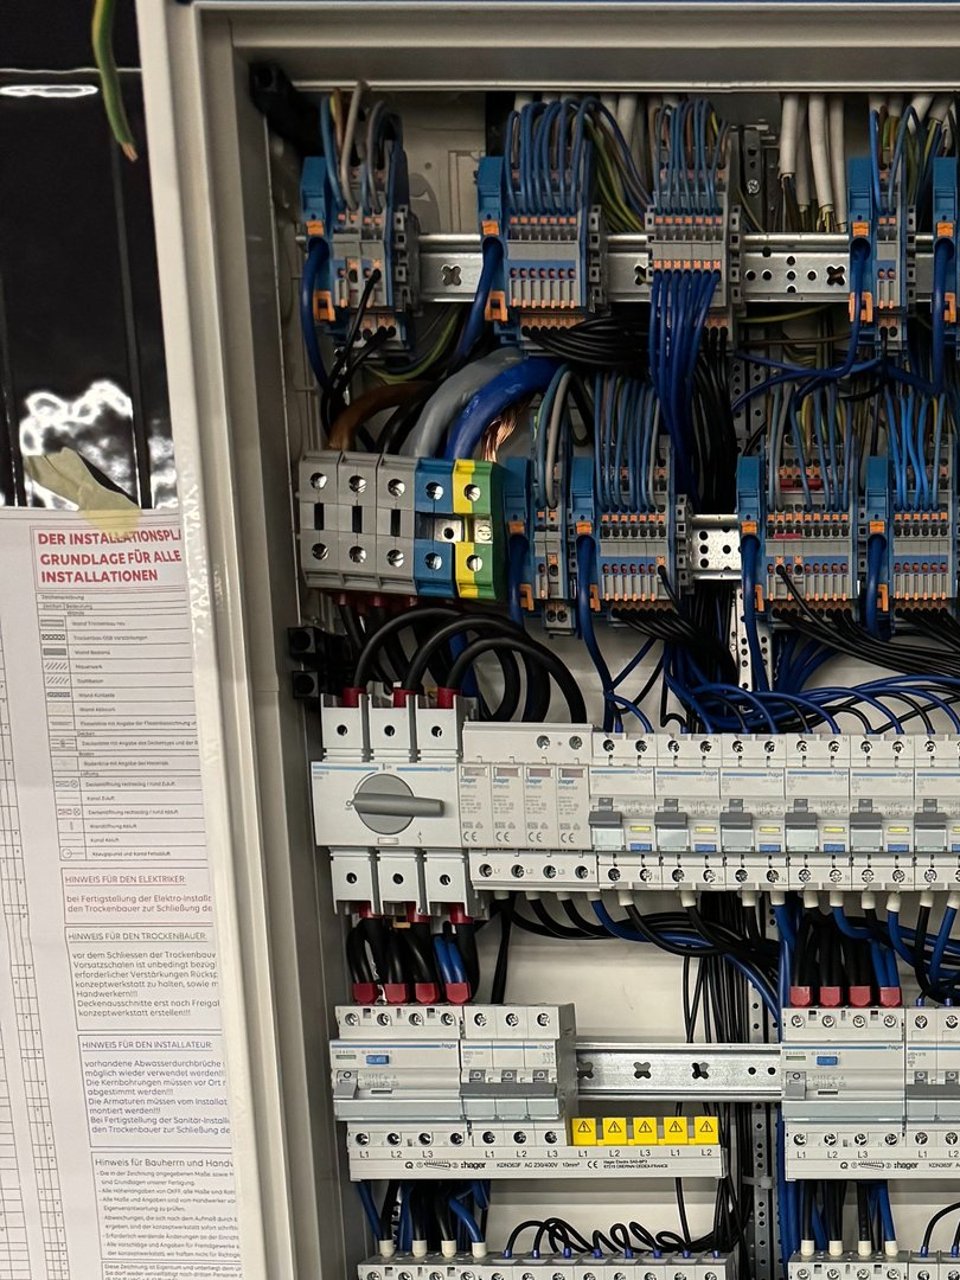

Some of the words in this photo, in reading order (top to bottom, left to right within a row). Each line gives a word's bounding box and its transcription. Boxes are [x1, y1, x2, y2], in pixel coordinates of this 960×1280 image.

[38, 533, 65, 545] DER
[40, 553, 125, 565] GRUNDLAGE
[128, 549, 150, 563] FÜR
[154, 550, 182, 562] ALLE
[42, 570, 158, 582] INSTALLATIONEN
[102, 875, 119, 883] FÜR
[81, 896, 136, 904] Fertigstellung
[157, 905, 200, 914] Schließung
[105, 932, 121, 940] FÜR
[148, 962, 188, 970] unbedingt
[130, 971, 189, 979] Verstärkungen
[76, 981, 145, 989] konzeptwerkstatt
[119, 1040, 134, 1048] FÜR
[640, 1149, 650, 1157] L3
[671, 1149, 680, 1157] L1
[948, 1150, 959, 1158] L2
[145, 1159, 184, 1167] Bauherrn
[187, 1159, 203, 1167] und
